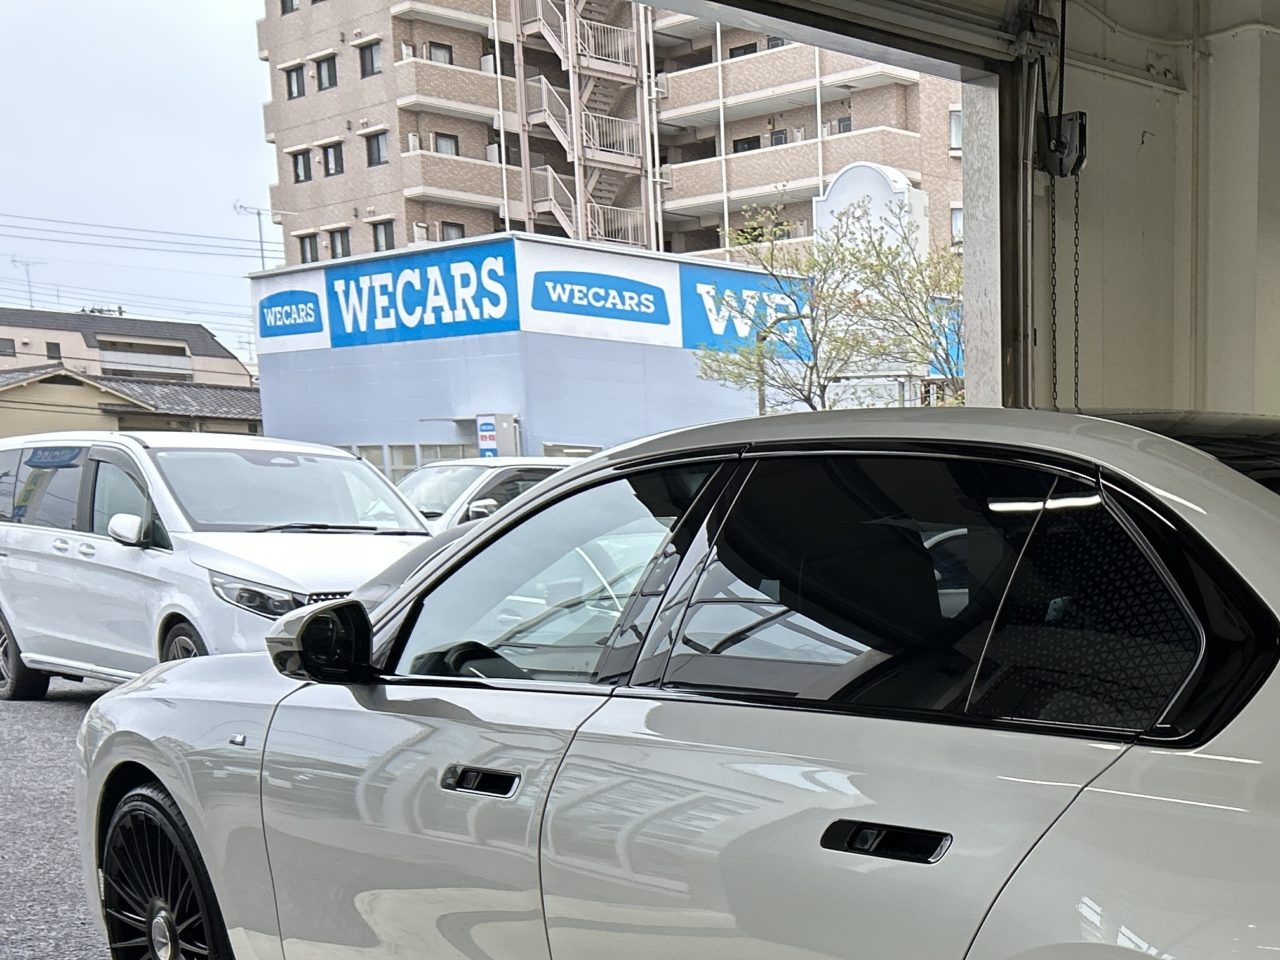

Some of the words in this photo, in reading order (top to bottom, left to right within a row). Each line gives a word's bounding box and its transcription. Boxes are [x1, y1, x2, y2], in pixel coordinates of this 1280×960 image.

[333, 255, 509, 334] WECARS
[544, 280, 656, 314] WECARS
[263, 302, 316, 328] WECARS
